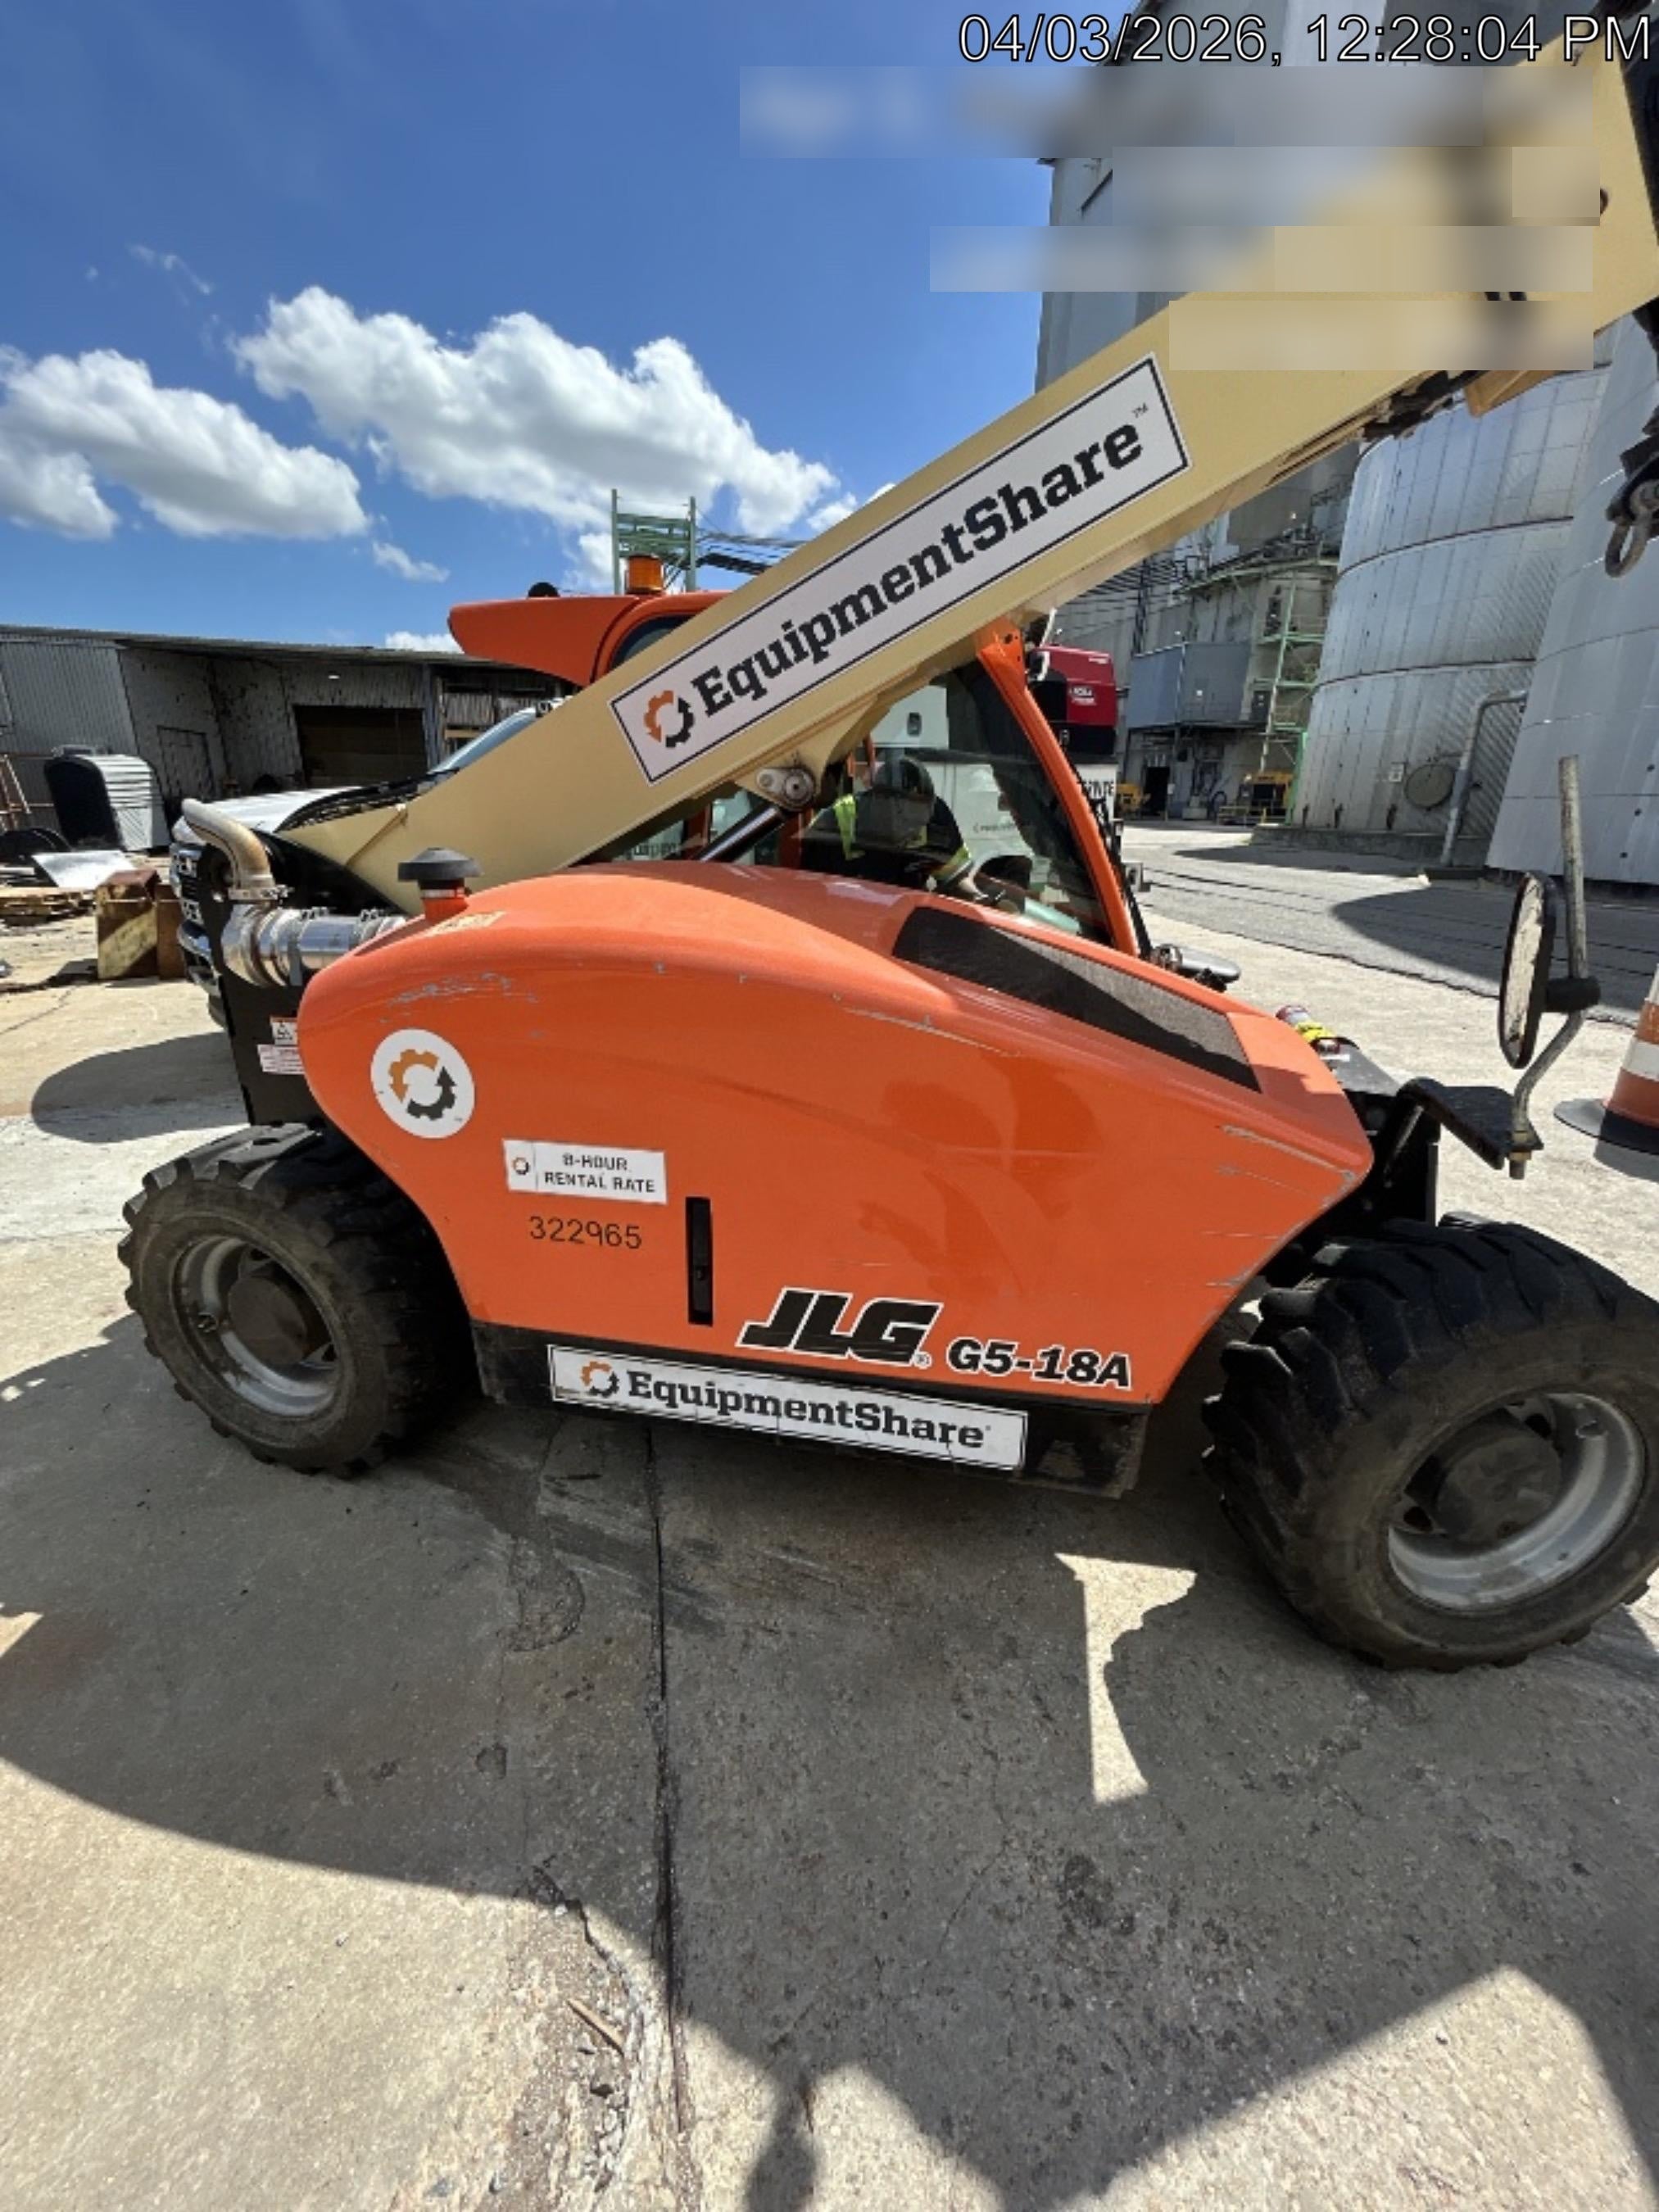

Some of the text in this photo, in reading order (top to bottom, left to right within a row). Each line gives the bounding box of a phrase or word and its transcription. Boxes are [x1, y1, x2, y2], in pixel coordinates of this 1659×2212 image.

[691, 424, 1144, 718] EquipmentShare
[544, 1172, 655, 1193] RENTAL RATE
[562, 1153, 628, 1171] 8-HOUR
[529, 1216, 642, 1249] 322965
[737, 1287, 1131, 1390] JLG G5-18A
[627, 1370, 985, 1448] EquipmentShare
